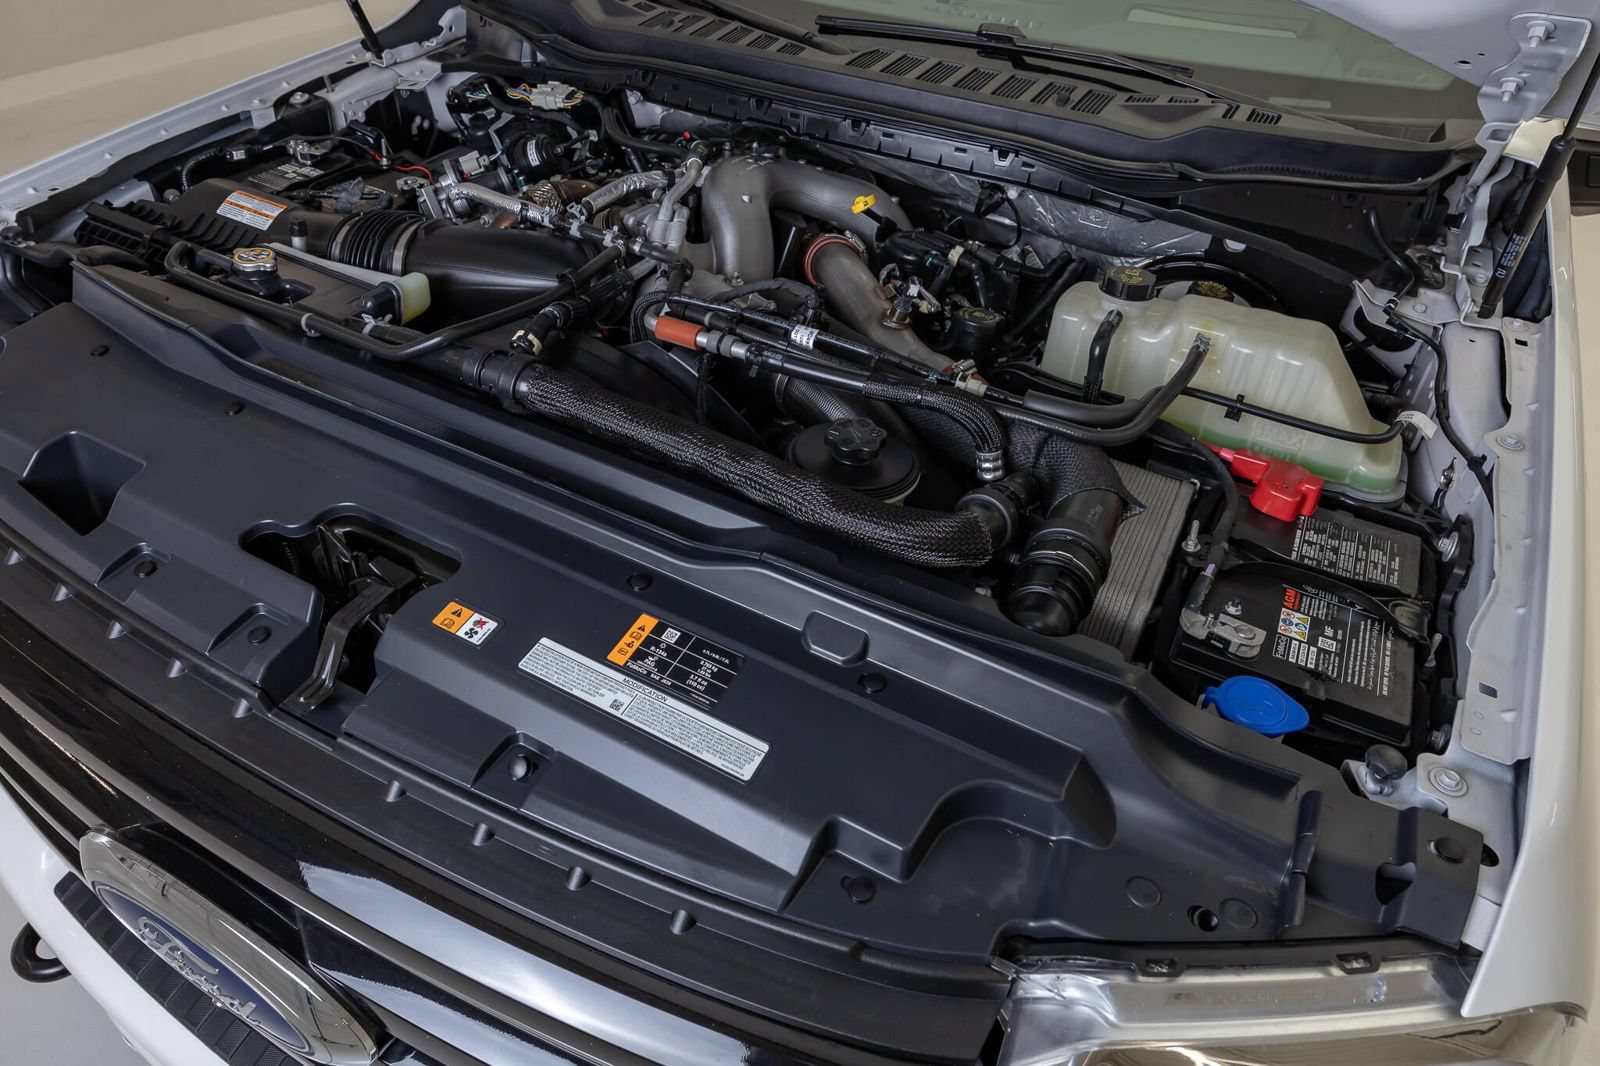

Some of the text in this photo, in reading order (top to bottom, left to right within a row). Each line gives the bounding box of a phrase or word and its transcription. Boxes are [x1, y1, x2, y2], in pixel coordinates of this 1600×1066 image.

[1283, 587, 1297, 609] AGM
[650, 646, 667, 657] R-134a
[1275, 636, 1287, 658] FoMoCo
[627, 662, 647, 675] FoMoCo
[644, 659, 655, 667] PAG
[622, 677, 668, 702] MODIFICATION
[135, 916, 262, 1025] Ford
